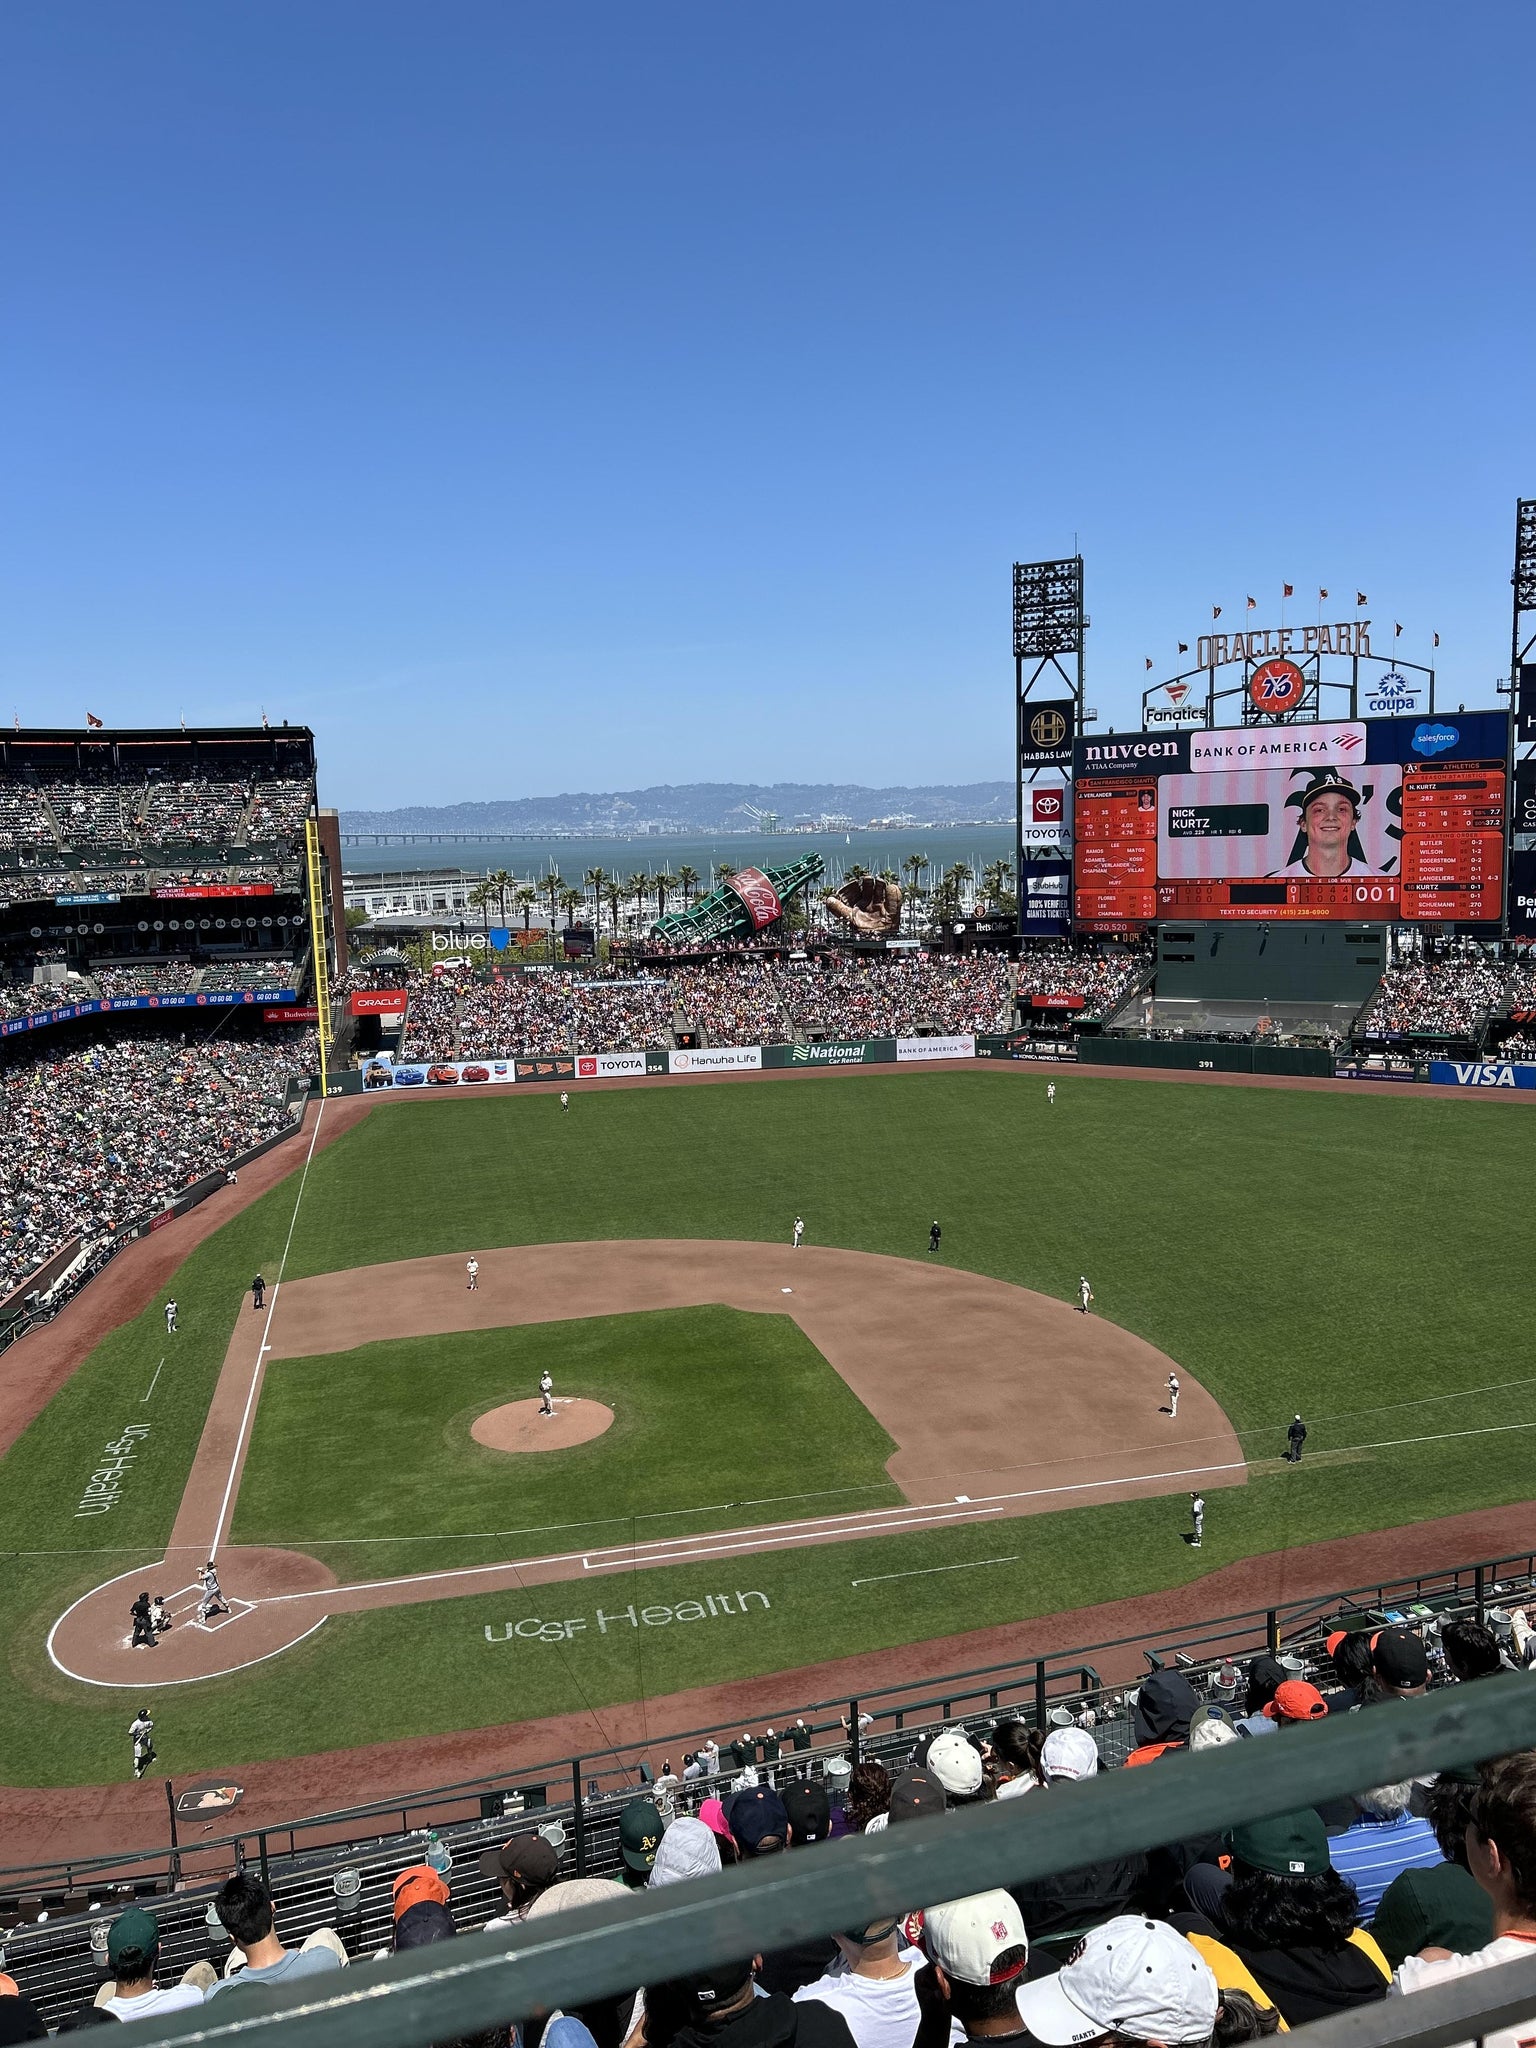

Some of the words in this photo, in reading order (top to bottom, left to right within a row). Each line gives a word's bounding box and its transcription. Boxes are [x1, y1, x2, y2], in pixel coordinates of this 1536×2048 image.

[1197, 628, 1293, 670] ORACLE
[1302, 620, 1372, 658] PARK
[1261, 673, 1293, 700] 76
[1369, 698, 1415, 713] coupa
[1146, 708, 1207, 723] Fanatics
[1417, 733, 1455, 744] salesforce
[1085, 740, 1180, 761] nuveen
[1194, 747, 1233, 758] BANK
[1238, 745, 1256, 756] OF
[1258, 741, 1328, 754] AMERICA
[1024, 751, 1054, 761] HABBAS
[1056, 750, 1073, 759] LAW
[1108, 762, 1138, 770] Company
[1172, 809, 1195, 818] NICK
[1172, 818, 1210, 829] KURTZ
[1024, 828, 1071, 839] TOYOTA
[1032, 881, 1064, 891] StubHub
[1290, 886, 1297, 894] 0
[1291, 895, 1296, 903] 1
[1355, 886, 1368, 902] 0
[1370, 886, 1383, 902] 0
[1387, 886, 1394, 902] 1
[1028, 900, 1044, 909] 100%
[1044, 899, 1068, 908] VERIFIED
[1026, 909, 1047, 918] GIANTS
[1047, 909, 1070, 918] TICKETS
[991, 922, 1009, 932] Coffee
[1093, 923, 1128, 932] $20,520
[432, 930, 486, 951] blue
[360, 948, 412, 965] Ghirardelli
[357, 998, 402, 1007] ORACLE
[809, 1044, 866, 1059] National
[927, 1045, 958, 1053] AMERICA
[600, 1060, 643, 1070] TOYOTA
[691, 1056, 735, 1065] Hanwha
[737, 1054, 757, 1063] Life
[841, 1056, 863, 1064] Rental
[1198, 1060, 1214, 1068] 391
[647, 1064, 663, 1072] 354
[1450, 1063, 1516, 1087] VISA
[326, 1086, 343, 1094] 339
[104, 1423, 152, 1455] UCSF
[73, 1455, 138, 1518] Health
[484, 1617, 588, 1643] UCSF
[595, 1590, 772, 1634] Health
[639, 1836, 658, 1852] A's
[1071, 2029, 1097, 2042] GIANTS
